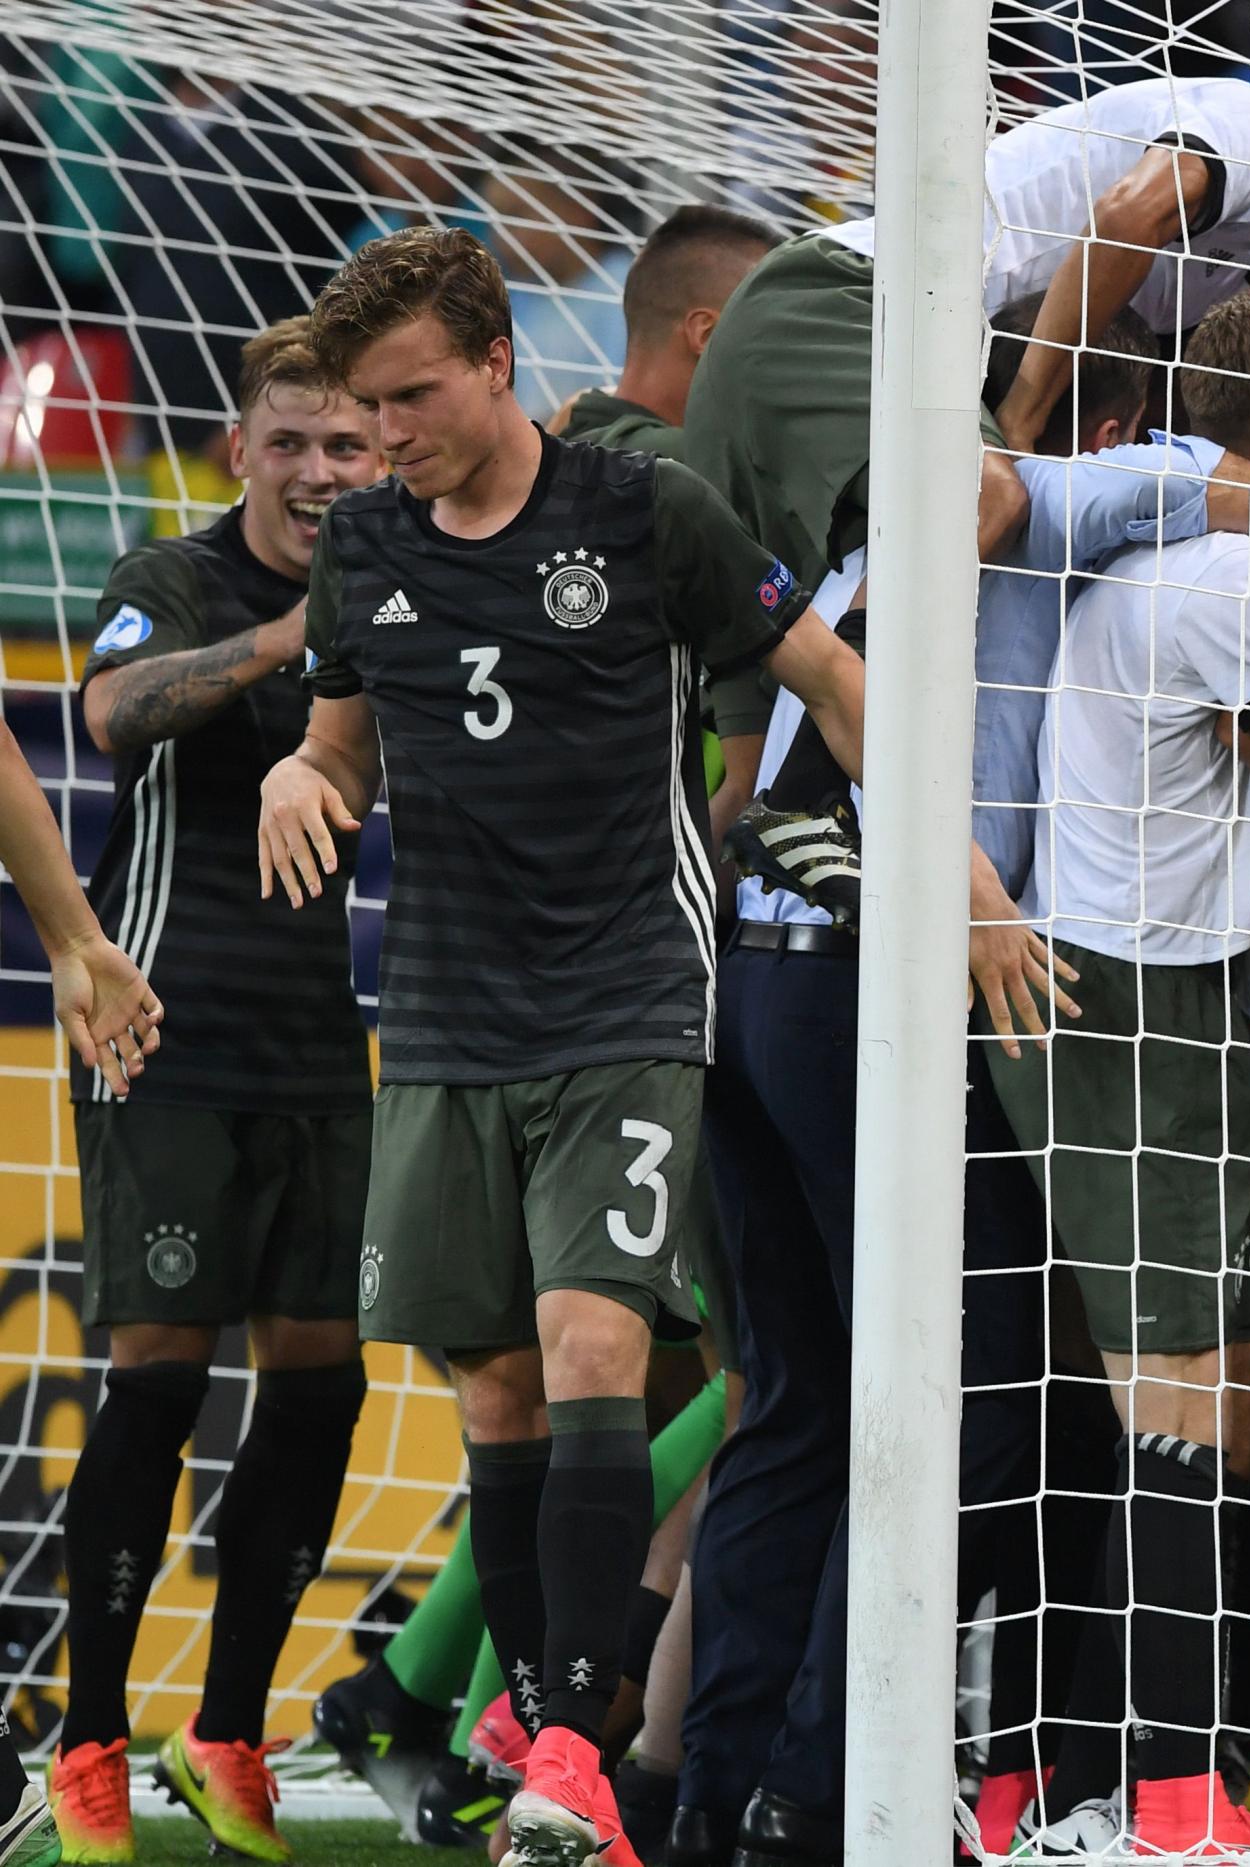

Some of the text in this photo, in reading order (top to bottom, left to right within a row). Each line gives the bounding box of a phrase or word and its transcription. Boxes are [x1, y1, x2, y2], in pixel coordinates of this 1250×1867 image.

[372, 610, 418, 625] adidas
[460, 646, 513, 740] 3
[607, 1118, 673, 1257] 3
